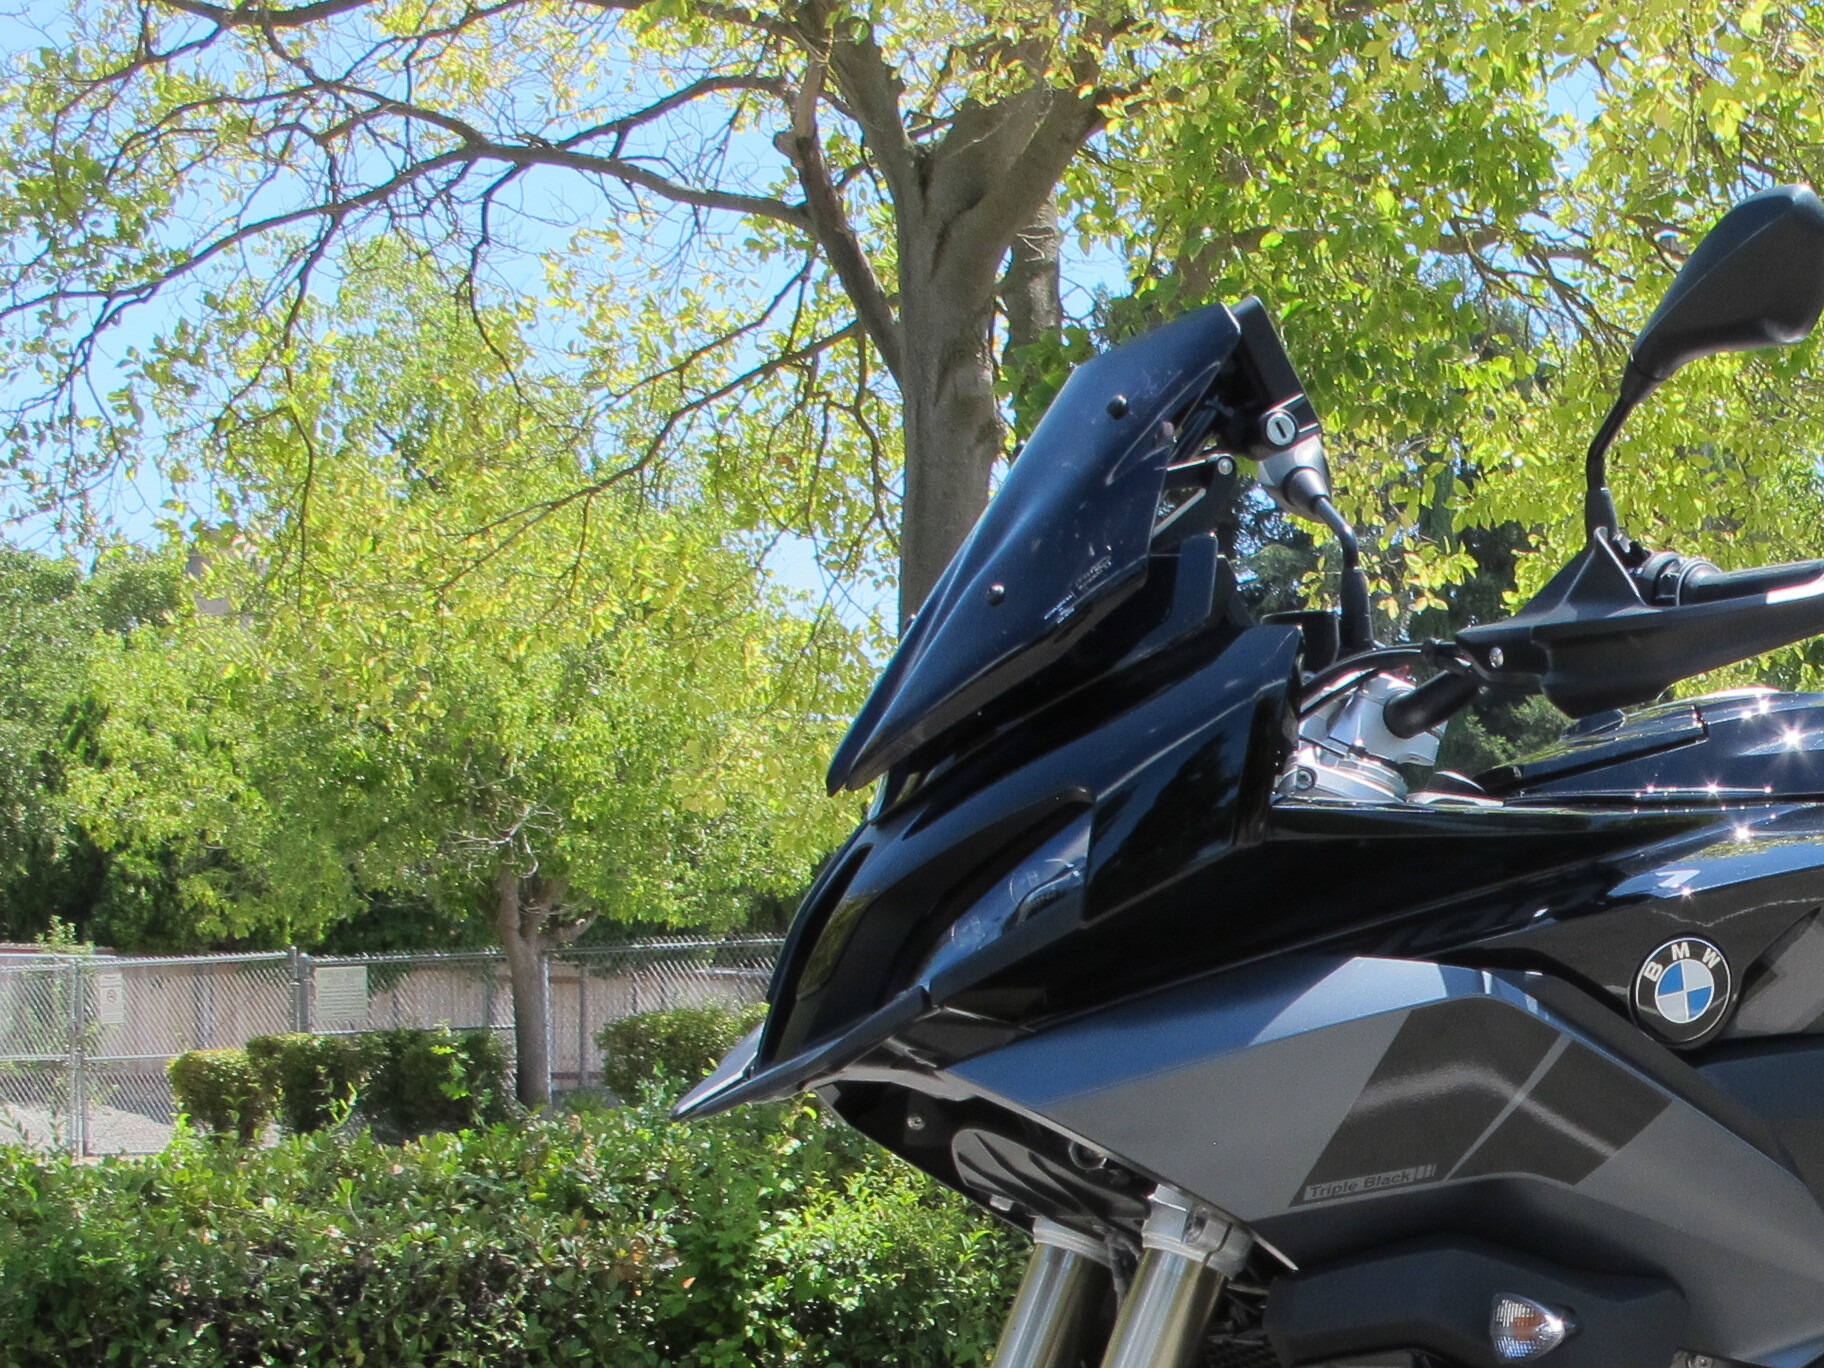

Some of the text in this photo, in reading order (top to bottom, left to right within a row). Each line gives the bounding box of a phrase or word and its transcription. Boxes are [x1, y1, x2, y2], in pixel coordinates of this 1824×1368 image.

[1644, 942, 1720, 982] BMW
[1311, 1171, 1410, 1197] Triple Black
